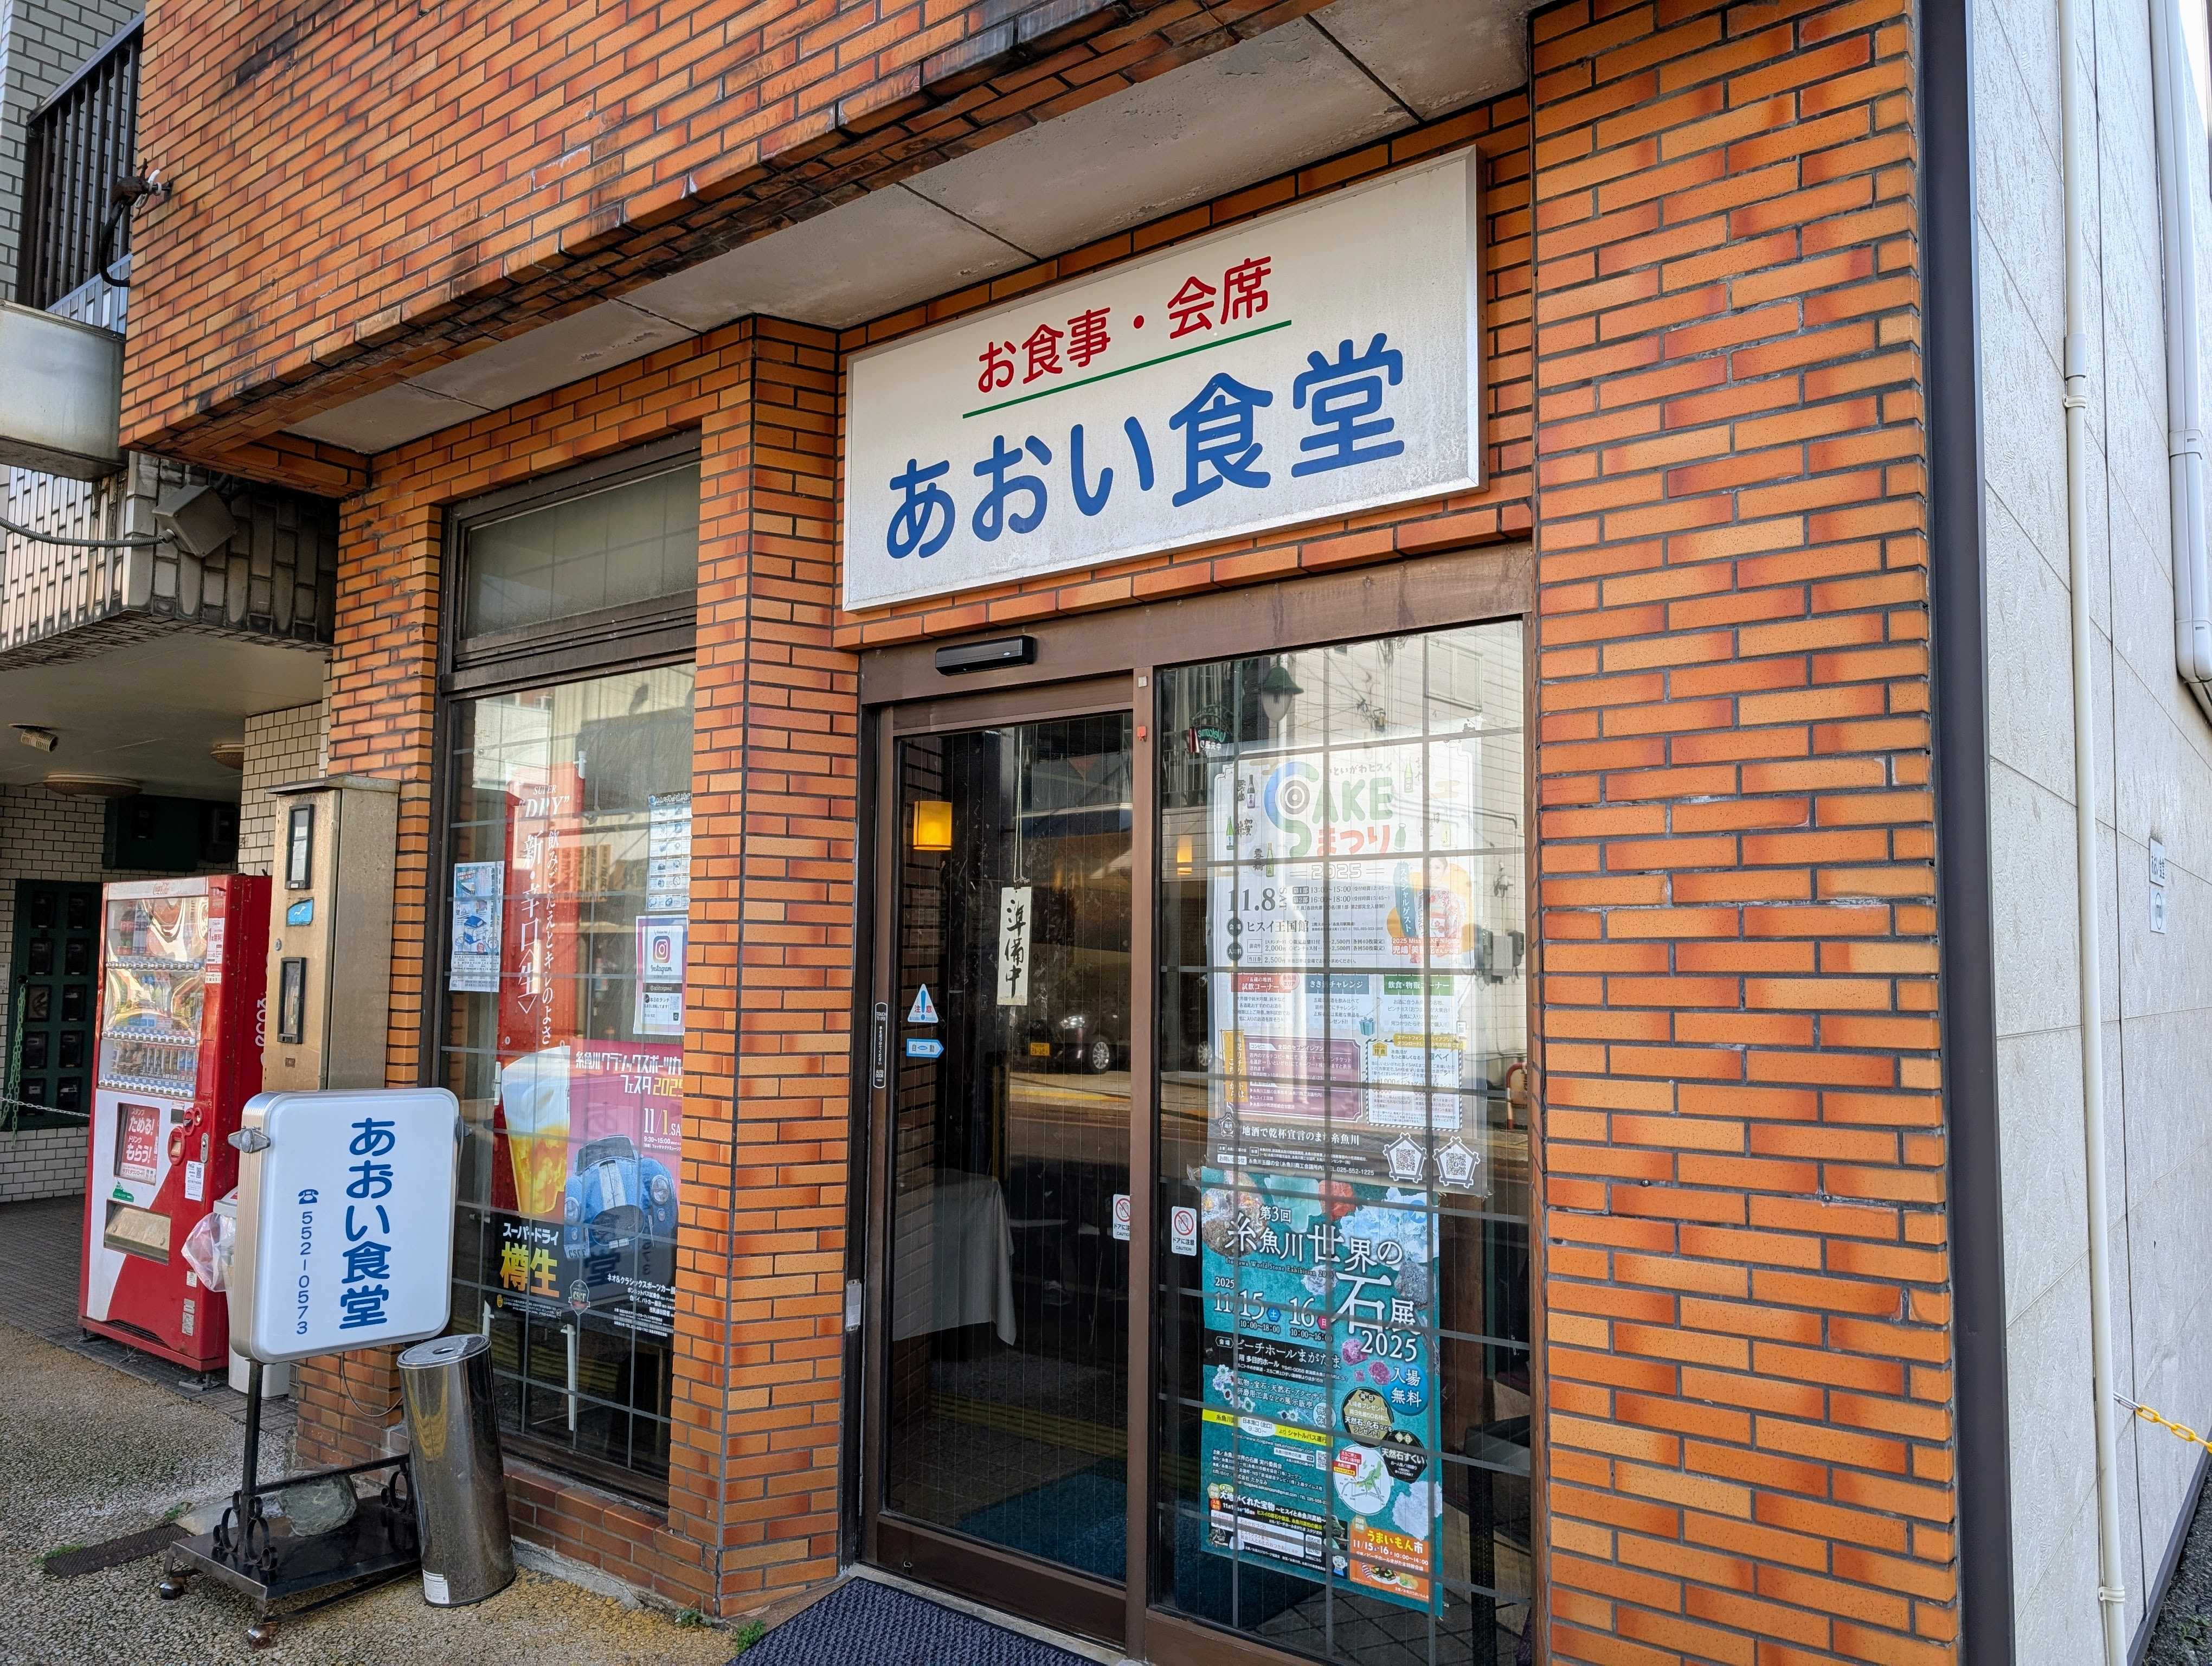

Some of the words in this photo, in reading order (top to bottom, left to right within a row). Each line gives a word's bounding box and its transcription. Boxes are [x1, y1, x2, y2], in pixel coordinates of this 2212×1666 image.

[978, 255, 1272, 394] お食事・会席
[886, 332, 1405, 560] あおい食堂
[1264, 761, 1393, 859] SAKE
[1317, 824, 1390, 856] まつり
[1311, 863, 1362, 880] 2025
[1227, 888, 1276, 912] 11.8
[1400, 868, 1411, 933] スペシャルゲスト
[1247, 920, 1309, 933] ヒスイ王国館
[1004, 899, 1026, 999] 準備中
[651, 964, 673, 974] Instagram
[1242, 983, 1279, 991] 試飲コーナー
[576, 1050, 683, 1076] 糸魚川クラシックスポーツカ
[128, 1116, 155, 1136] ためる!
[128, 1135, 142, 1144] ドリンク
[1331, 1133, 1360, 1146] 糸魚川
[126, 1143, 152, 1164] もらう!
[1328, 1166, 1374, 1176] EL.025-552-1225
[339, 1117, 395, 1330] あおい食堂
[1259, 1204, 1291, 1223] 第3回
[503, 1222, 560, 1246] スーパードライ
[1114, 1223, 1130, 1231] ドアに注
[1173, 1237, 1195, 1246] ドアに注意
[1224, 1212, 1403, 1273] 糸魚川世界の
[500, 1241, 560, 1298] 樽生
[1226, 1256, 1249, 1267] Itoawa
[1251, 1261, 1268, 1269] World
[1269, 1263, 1285, 1272] Stone
[1287, 1266, 1316, 1276] Exhibition
[1214, 1277, 1235, 1289] 2025
[1270, 1310, 1278, 1318] 土
[1289, 1297, 1315, 1327] 16
[1240, 1320, 1280, 1334] 10:00~18:00
[1237, 1338, 1342, 1369] ビーチホールまがたま
[1361, 1330, 1418, 1362] 2025
[1246, 1355, 1279, 1368] 多目的ホール
[1391, 1367, 1422, 1387] 入場
[1391, 1387, 1422, 1408] 無料
[1248, 1425, 1267, 1434] 9:30~
[1345, 1416, 1393, 1433] 天然石、化石などを
[1354, 1426, 1380, 1438] プレゼント!
[1288, 1429, 1327, 1444] シャトルバス運行
[1381, 1447, 1425, 1464] 天然石すくい
[1367, 1529, 1423, 1554] うまいもん市
